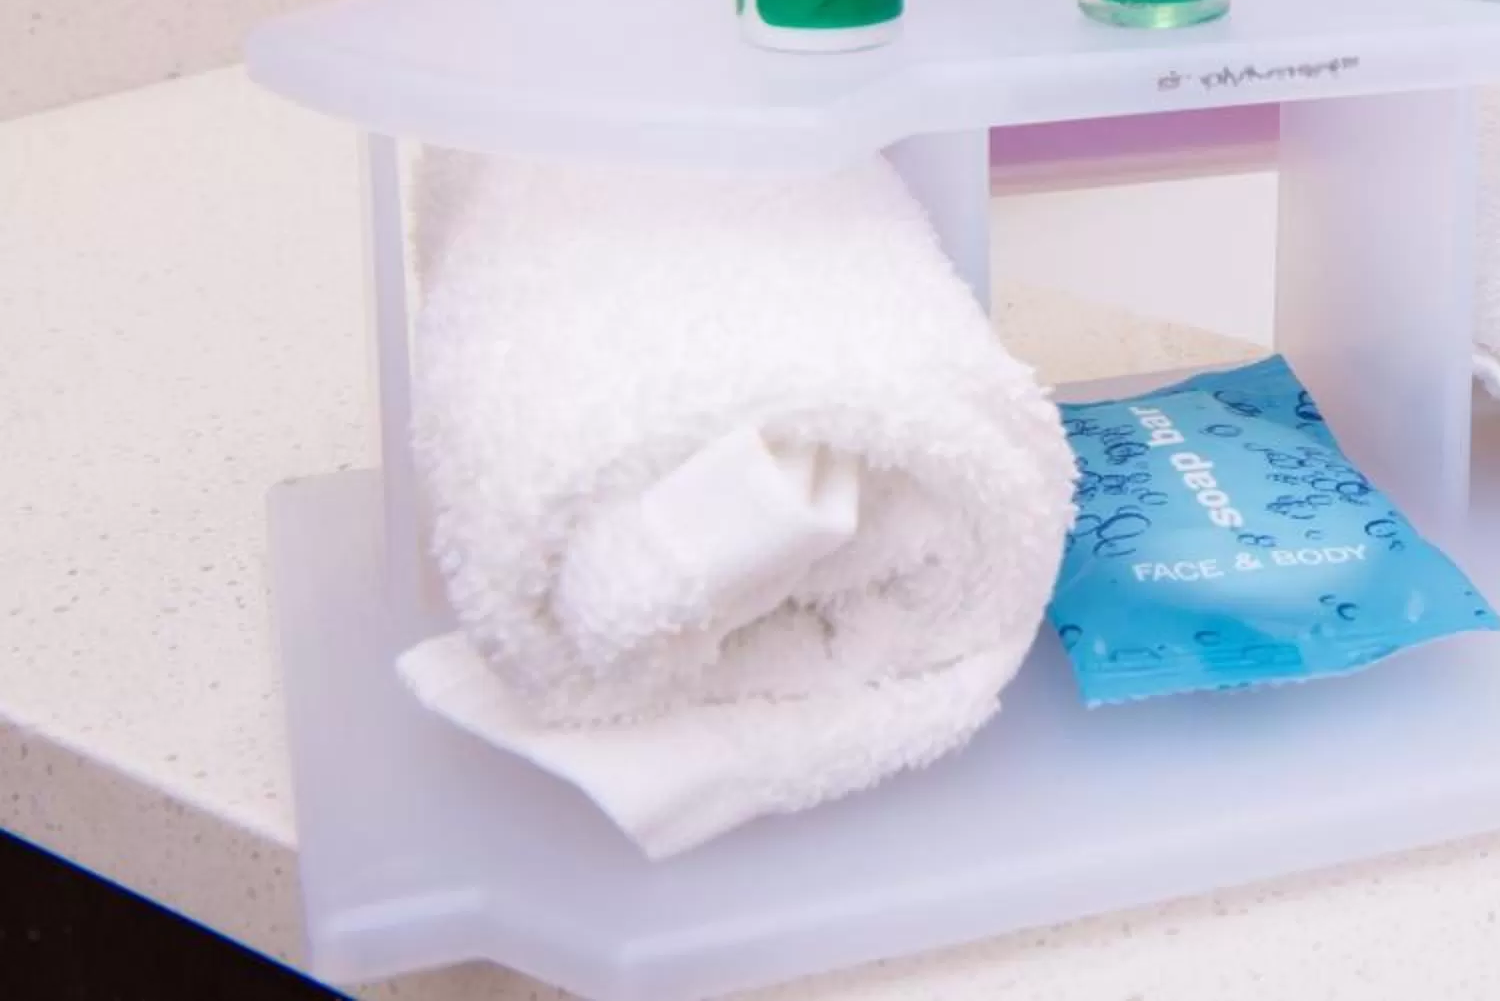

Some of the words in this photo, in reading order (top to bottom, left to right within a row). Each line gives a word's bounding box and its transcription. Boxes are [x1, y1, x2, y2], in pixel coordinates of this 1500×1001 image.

[1129, 404, 1186, 449] bar
[1168, 451, 1246, 531] soap
[1131, 557, 1226, 583] FACE
[1233, 551, 1265, 572] &
[1270, 543, 1370, 567] BODY
